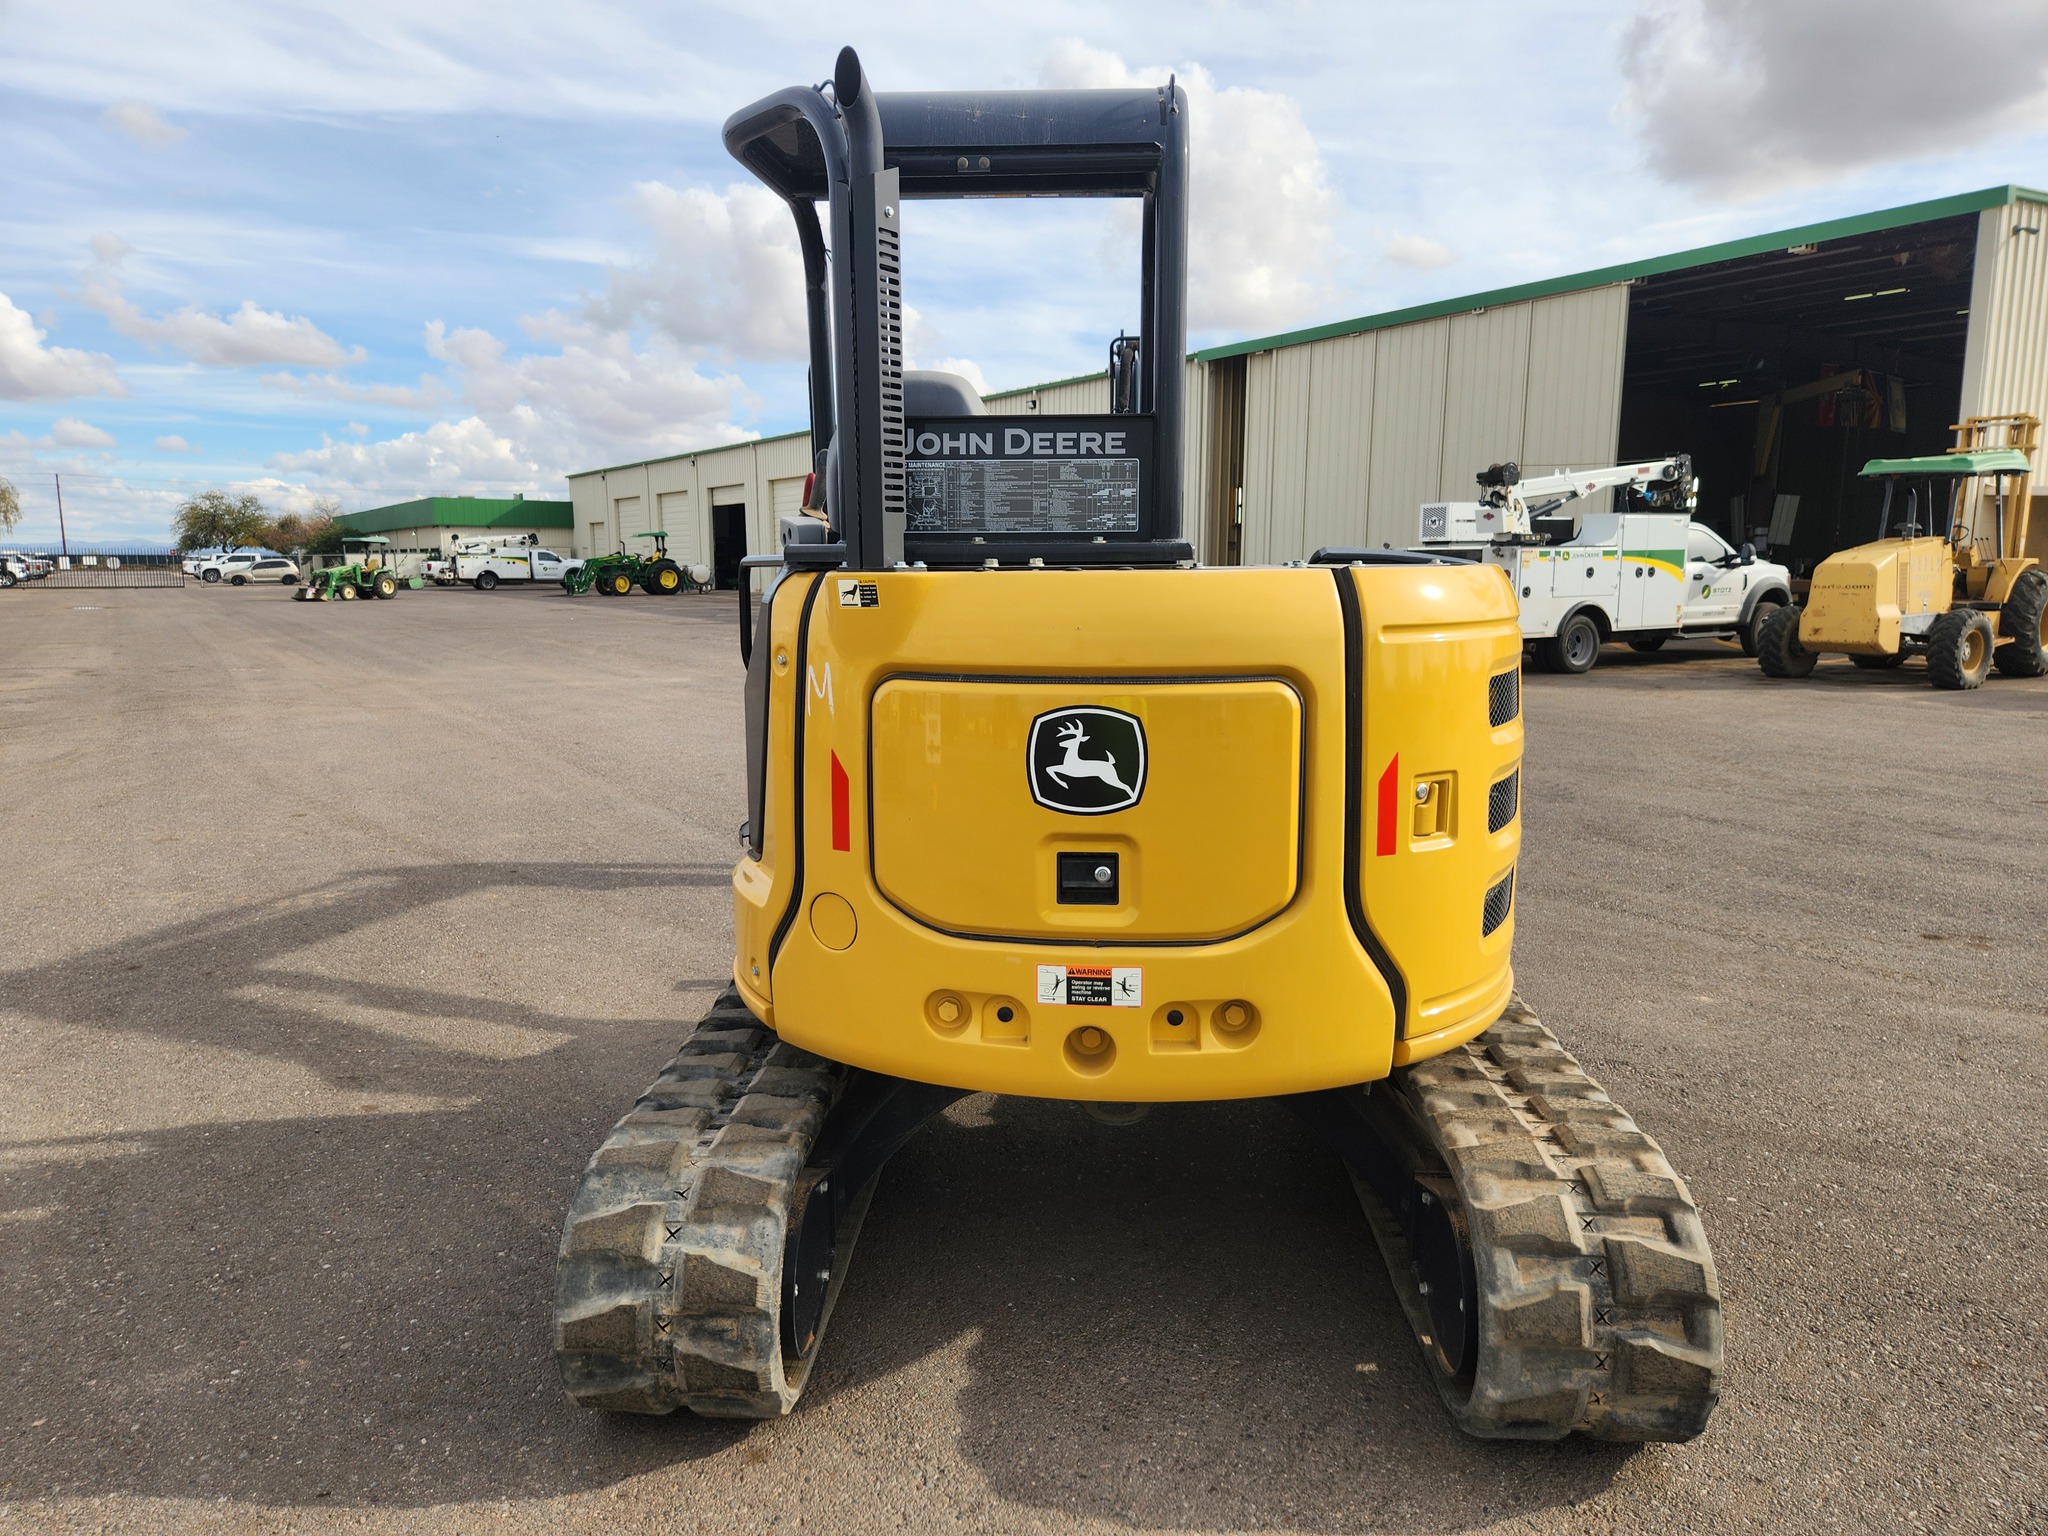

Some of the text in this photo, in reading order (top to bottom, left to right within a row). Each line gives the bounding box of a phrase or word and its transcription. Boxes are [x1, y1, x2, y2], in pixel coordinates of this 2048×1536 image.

[904, 428, 1126, 455] JOHN DEERE
[807, 662, 835, 719] M
[1076, 968, 1111, 976] WARNING
